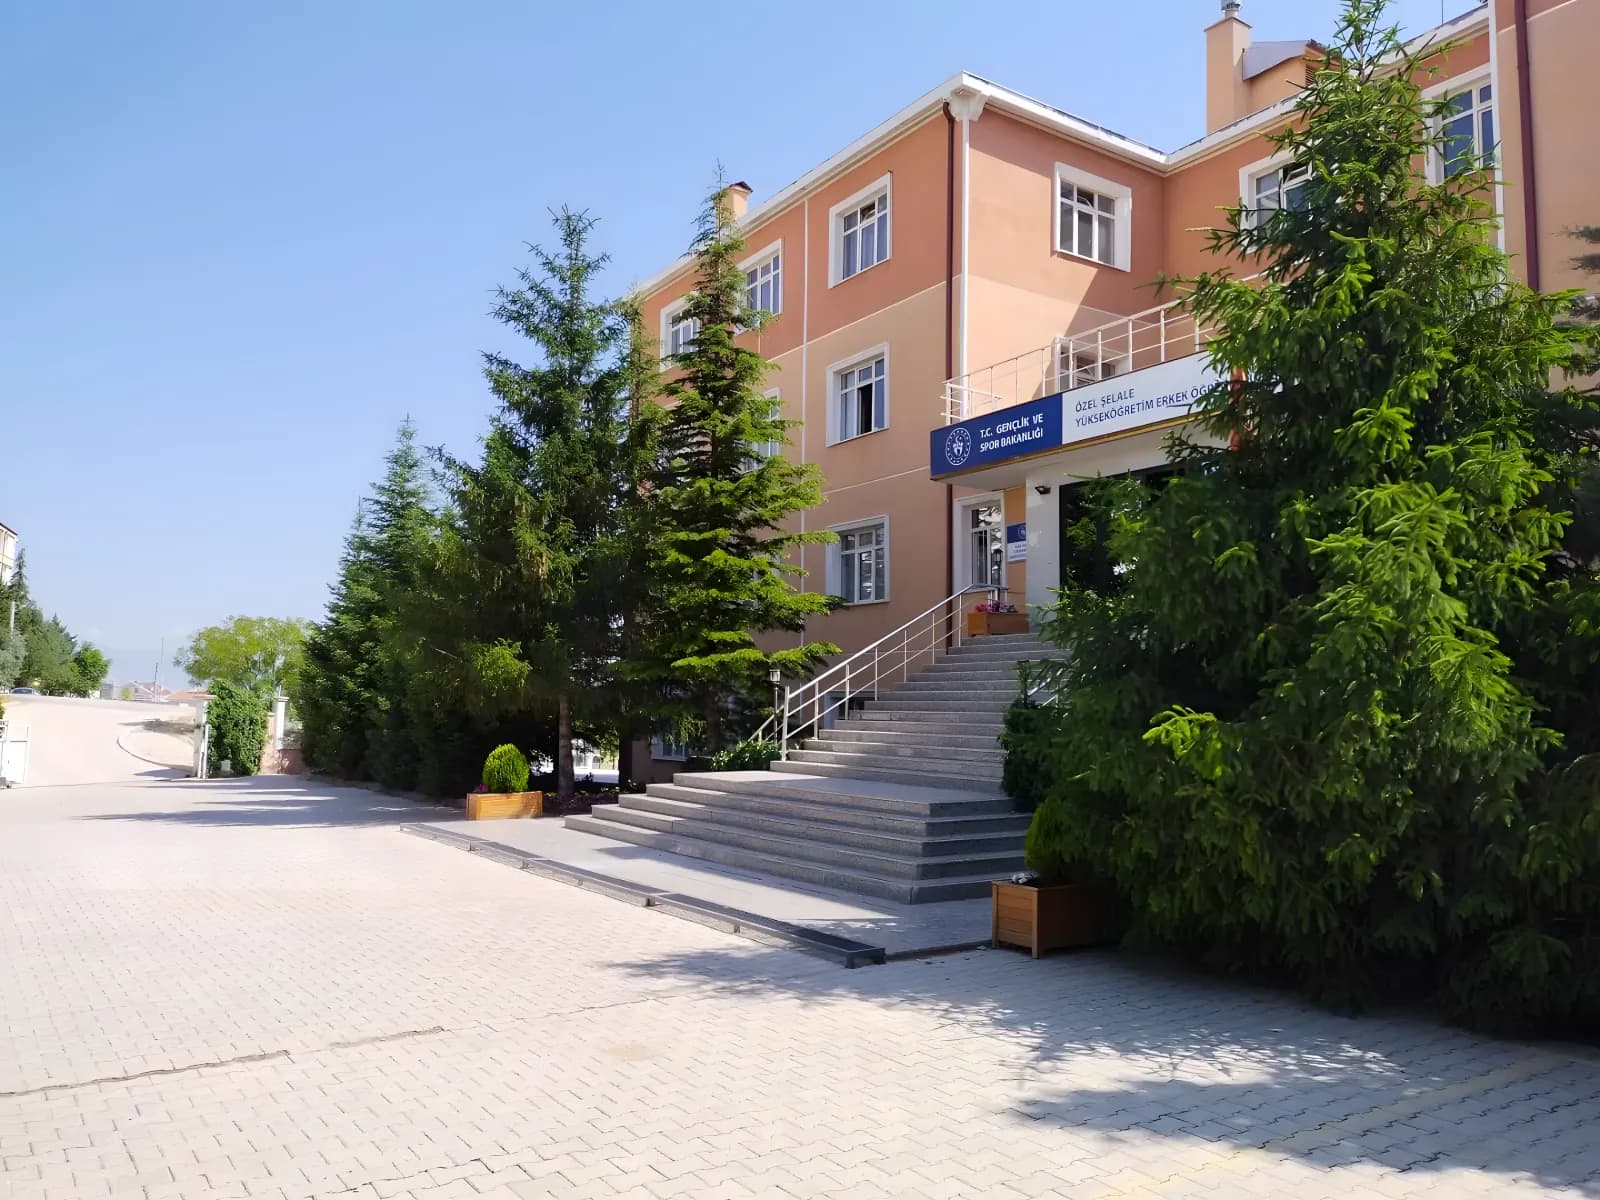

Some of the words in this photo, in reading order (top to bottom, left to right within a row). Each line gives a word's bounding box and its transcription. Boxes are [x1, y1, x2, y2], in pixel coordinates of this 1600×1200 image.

[1075, 399, 1097, 412] ÖZEL
[1156, 388, 1188, 407] ERKEK
[980, 427, 993, 439] T.C.
[996, 416, 1030, 434] GENÇLİK
[1032, 413, 1044, 424] VE
[979, 439, 1000, 453] SPOR
[1000, 428, 1044, 447] BAKANLIĞI
